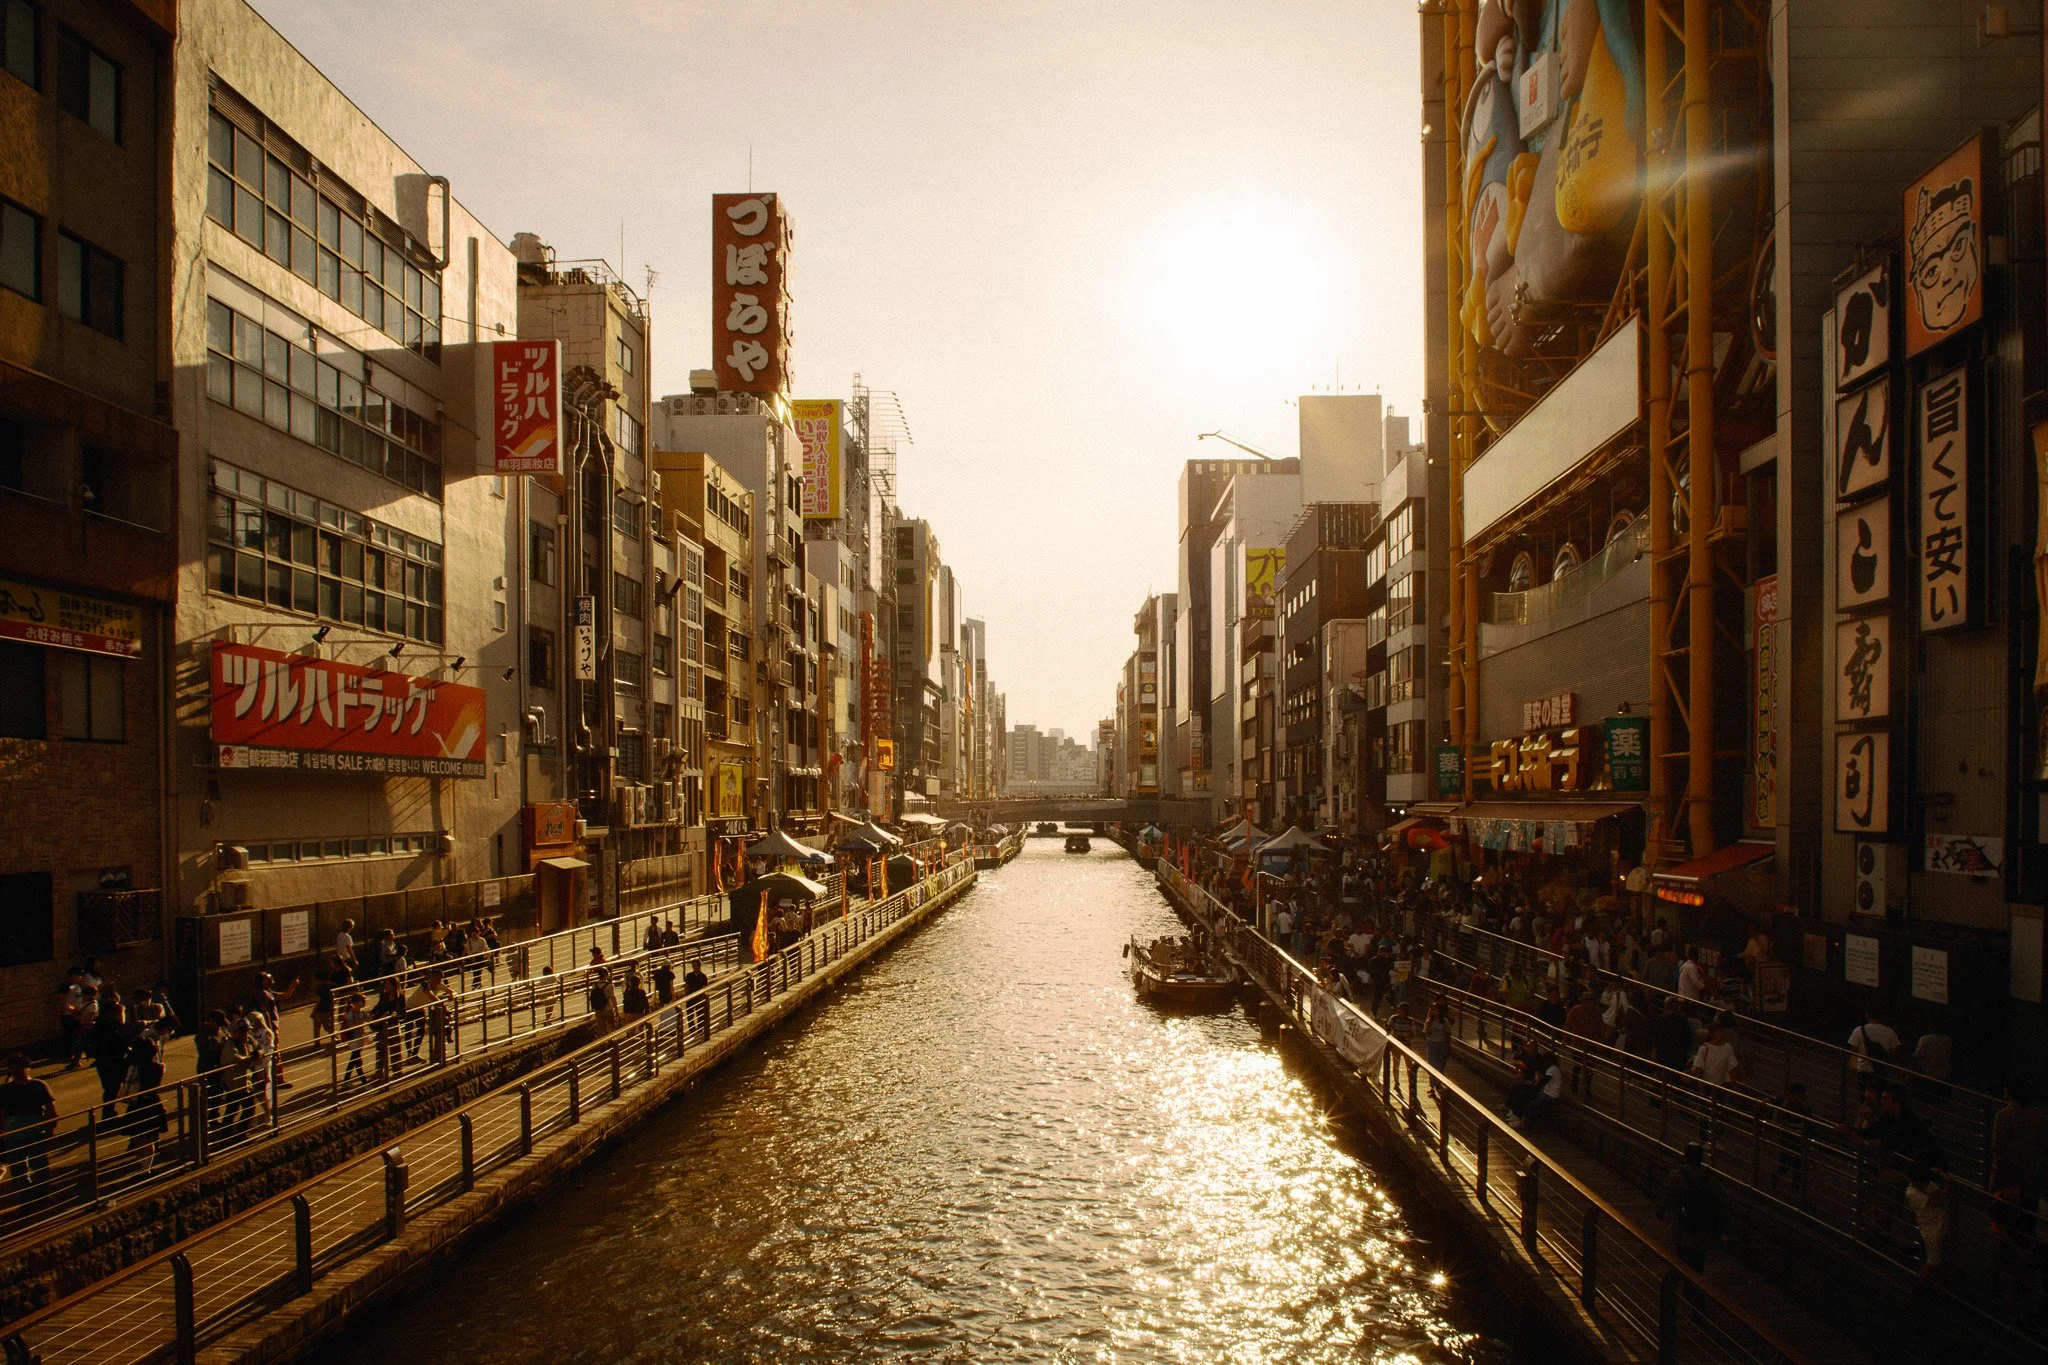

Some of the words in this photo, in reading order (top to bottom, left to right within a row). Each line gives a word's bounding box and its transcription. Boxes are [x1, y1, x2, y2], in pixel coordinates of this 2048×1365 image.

[726, 194, 775, 383] づぼらや
[500, 360, 522, 440] ドラッグ
[524, 347, 550, 421] ツルハ
[1925, 378, 1963, 622] 旨くて安い
[25, 626, 84, 647] お好み焼き
[579, 599, 592, 625] 焼肉
[580, 627, 592, 678] いろりや
[221, 653, 434, 737] ツルハドラッグ
[337, 754, 363, 771] SALE
[422, 759, 462, 775] WELCOME
